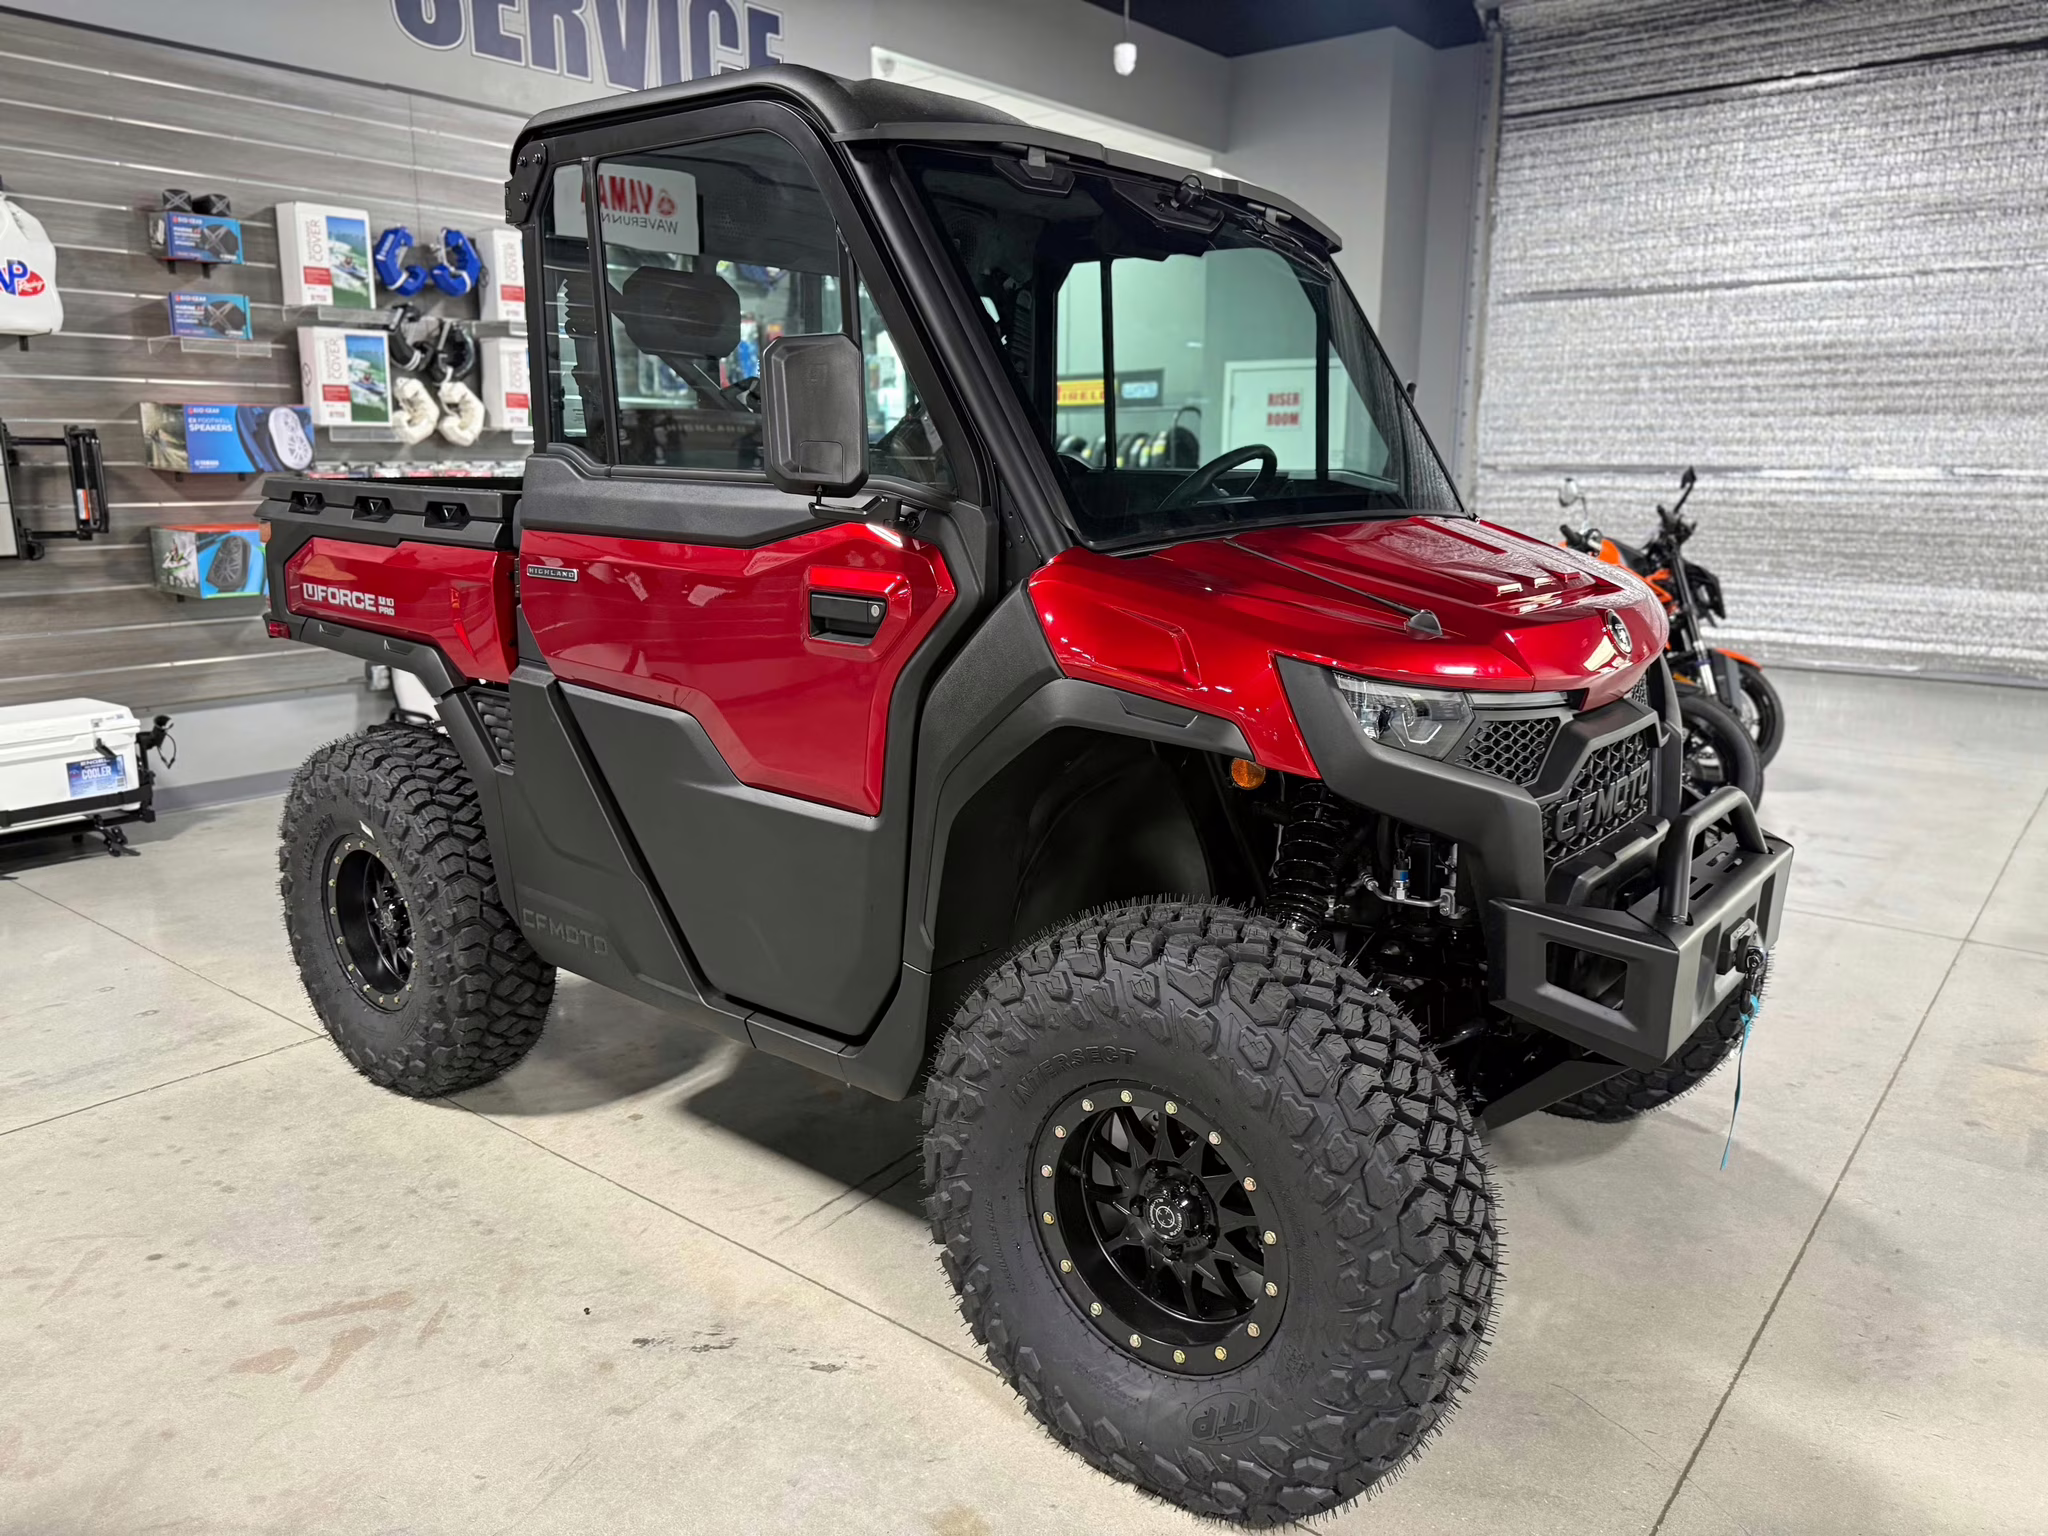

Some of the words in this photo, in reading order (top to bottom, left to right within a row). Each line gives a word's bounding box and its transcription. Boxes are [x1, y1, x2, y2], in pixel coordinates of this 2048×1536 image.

[310, 219, 324, 262] COVER
[329, 338, 343, 380] COVER
[1267, 391, 1300, 407] RISER
[188, 423, 233, 432] SPEAKERS
[1266, 411, 1300, 427] ROOM
[528, 567, 575, 578] HIGHLAND
[378, 605, 395, 616] PRO
[81, 765, 112, 780] COOLER
[1556, 760, 1651, 841] CFMOTO
[522, 907, 609, 956] CFMOTO
[1009, 1045, 1137, 1109] INTERSECT
[1191, 1399, 1259, 1441] ITP
